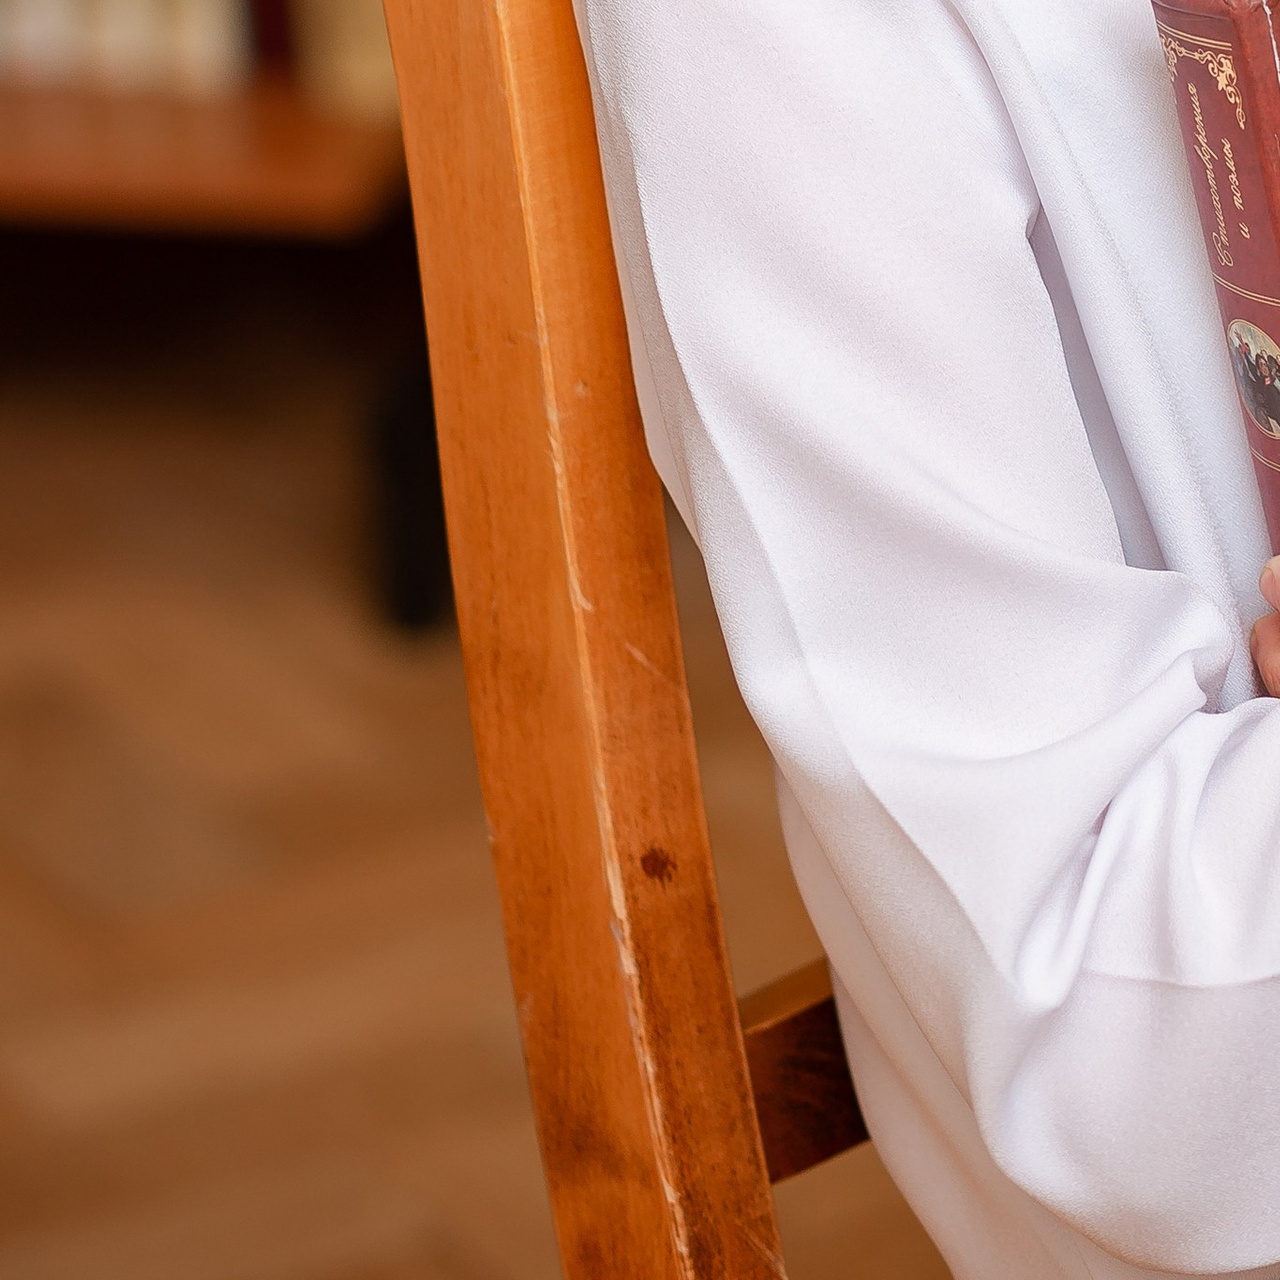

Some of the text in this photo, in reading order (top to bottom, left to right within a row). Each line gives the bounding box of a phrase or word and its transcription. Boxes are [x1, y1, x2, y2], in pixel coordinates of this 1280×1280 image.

[1187, 82, 1234, 267] Стихотворения
[1221, 138, 1250, 239] и поэмы
